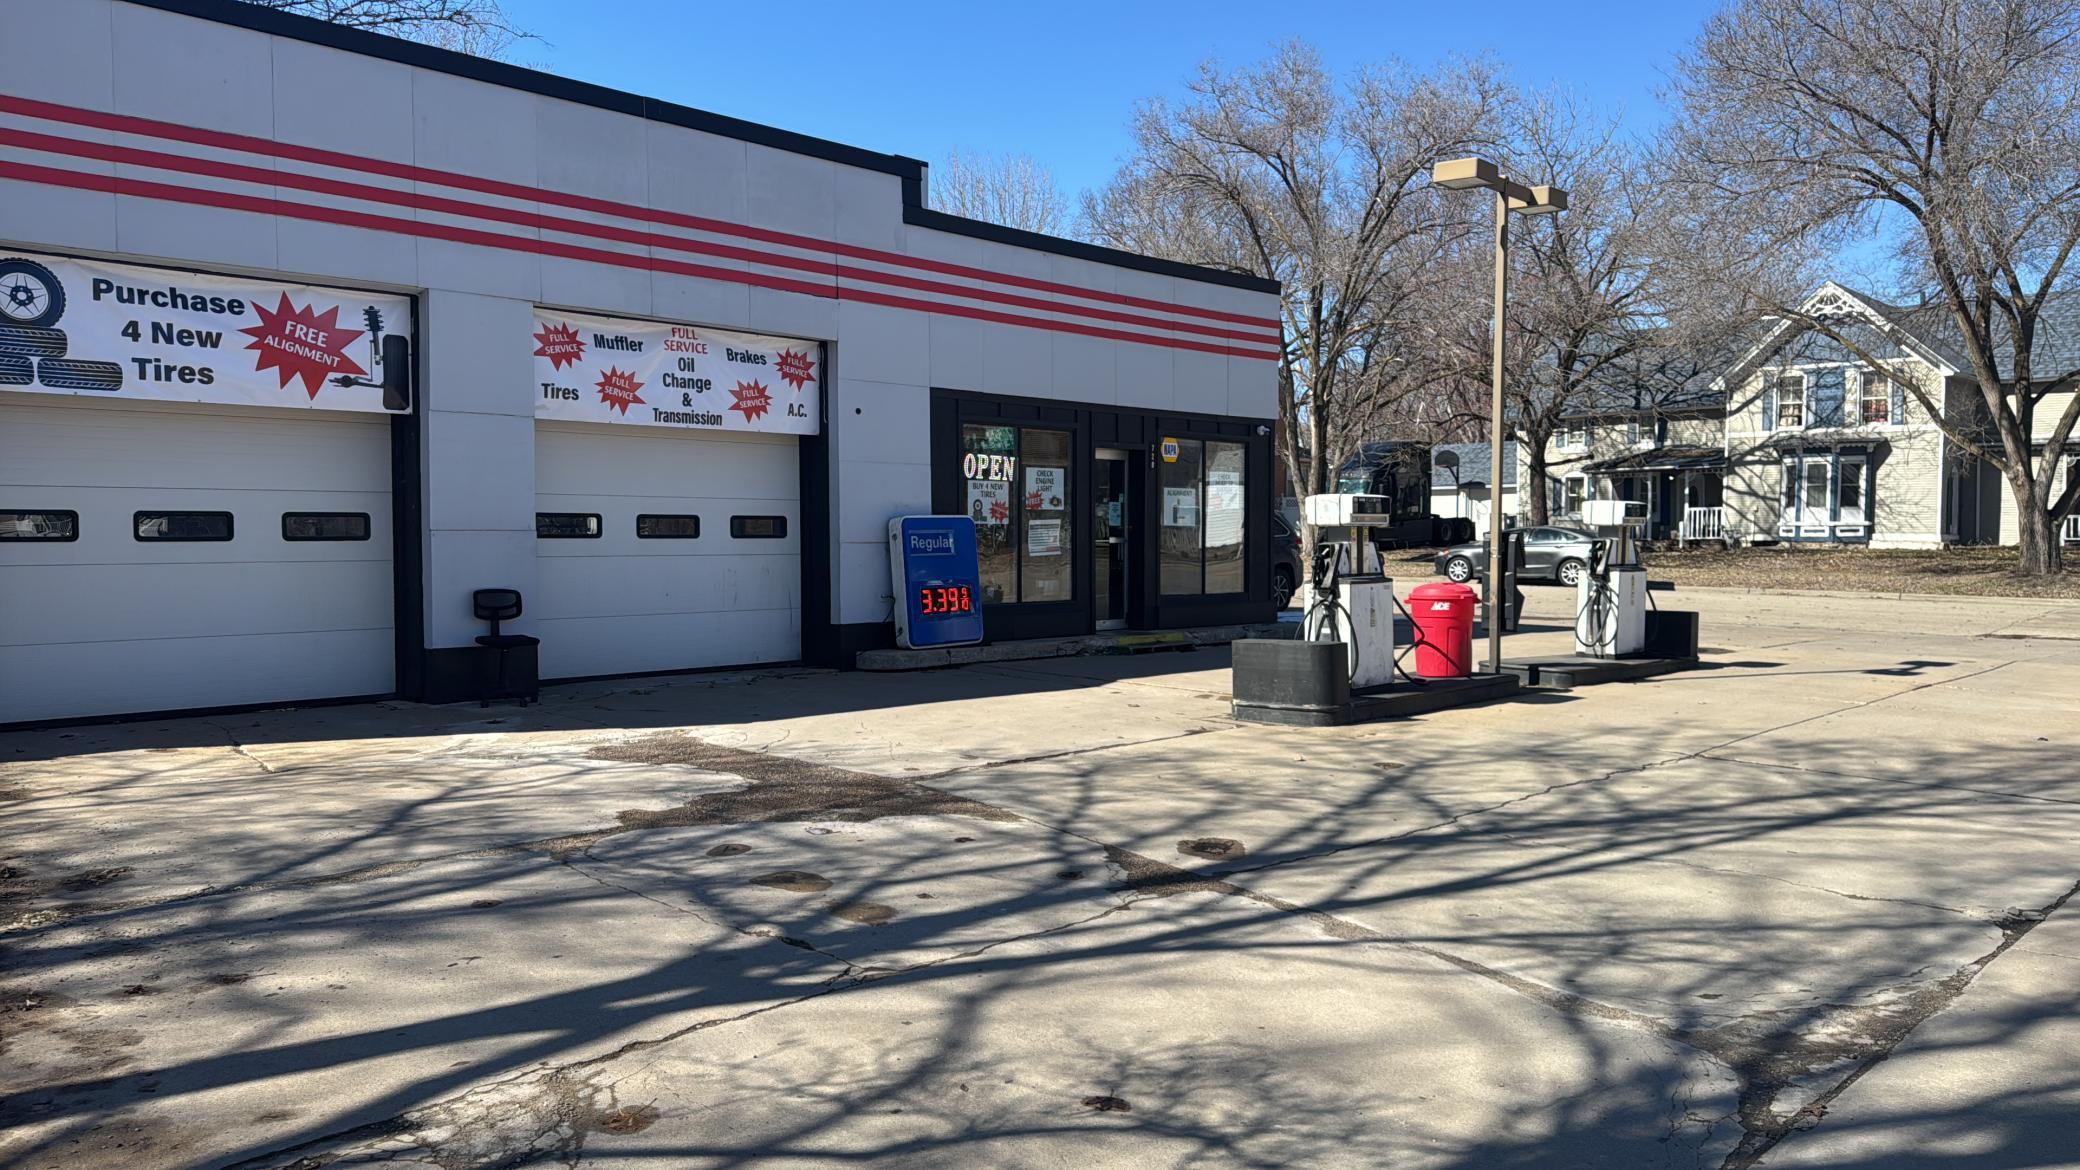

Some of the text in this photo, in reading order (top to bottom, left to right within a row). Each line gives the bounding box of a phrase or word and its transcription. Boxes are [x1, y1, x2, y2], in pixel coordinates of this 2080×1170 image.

[92, 277, 245, 316] Purchase
[121, 320, 223, 349] 4 New
[284, 320, 329, 348] FREE
[549, 333, 570, 343] FULL
[671, 327, 698, 340] FULL
[545, 343, 579, 355] SERVICE
[593, 333, 644, 353] Muffler
[664, 340, 708, 355] SERVICE
[263, 334, 341, 368] ALIGNMENT
[726, 348, 768, 366] Brakes
[677, 357, 695, 373] Oil
[787, 356, 805, 367] FULL
[131, 357, 215, 385] Tires
[782, 365, 808, 377] SERVICE
[611, 375, 630, 389] FULL
[662, 373, 712, 393] Change
[541, 383, 580, 402] Tires
[604, 385, 634, 401] SERVICE
[682, 393, 693, 407] &
[742, 388, 760, 398] FULL
[739, 397, 767, 409] SERVICE
[787, 403, 807, 418] A.C.
[652, 407, 723, 426] Transmission
[964, 453, 1016, 481] OPEN
[1036, 469, 1054, 477] CHECK
[972, 482, 984, 490] BUY
[1035, 477, 1055, 485] ENGINE
[1037, 485, 1052, 493] LIGHT
[910, 535, 953, 551] Regular
[922, 587, 959, 614] 3.39
[1429, 601, 1451, 611] ACE
